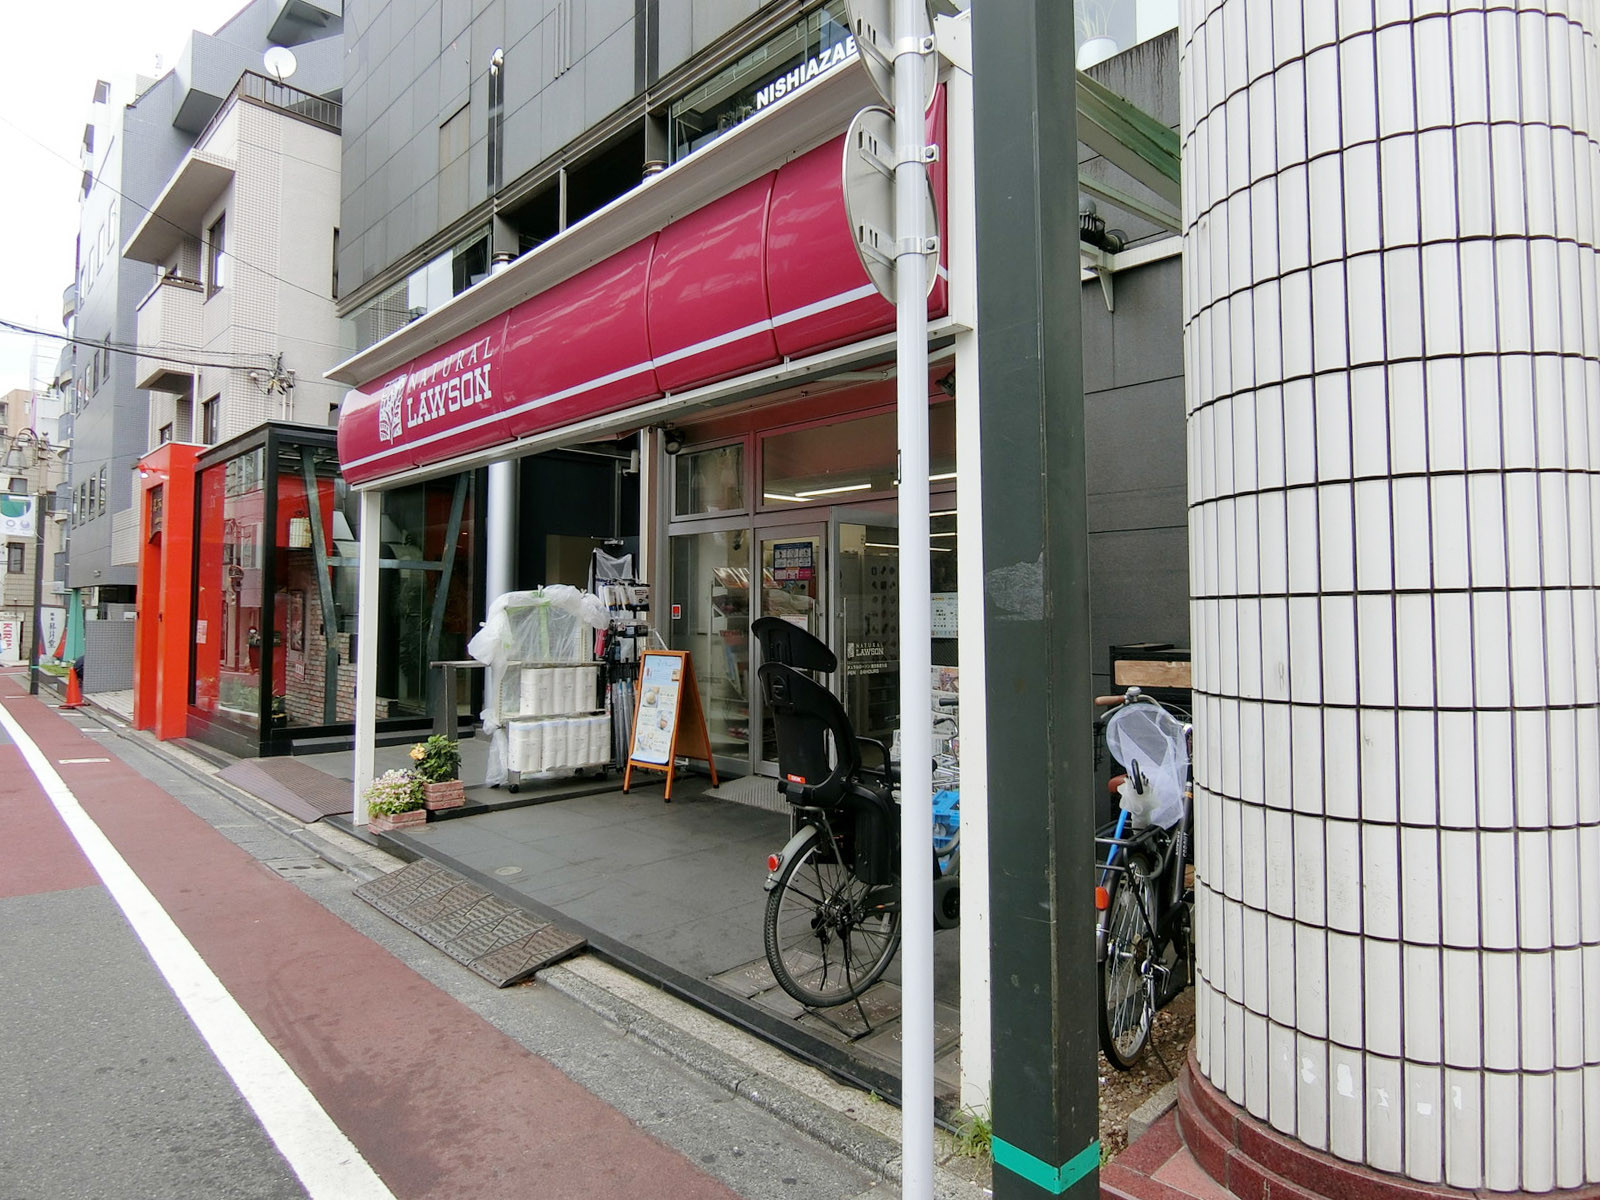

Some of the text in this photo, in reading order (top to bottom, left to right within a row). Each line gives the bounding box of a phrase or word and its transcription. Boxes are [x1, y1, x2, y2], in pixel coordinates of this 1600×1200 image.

[406, 336, 493, 393] NATURAL
[407, 363, 491, 428] LAWSON
[856, 648, 884, 656] LAWSON
